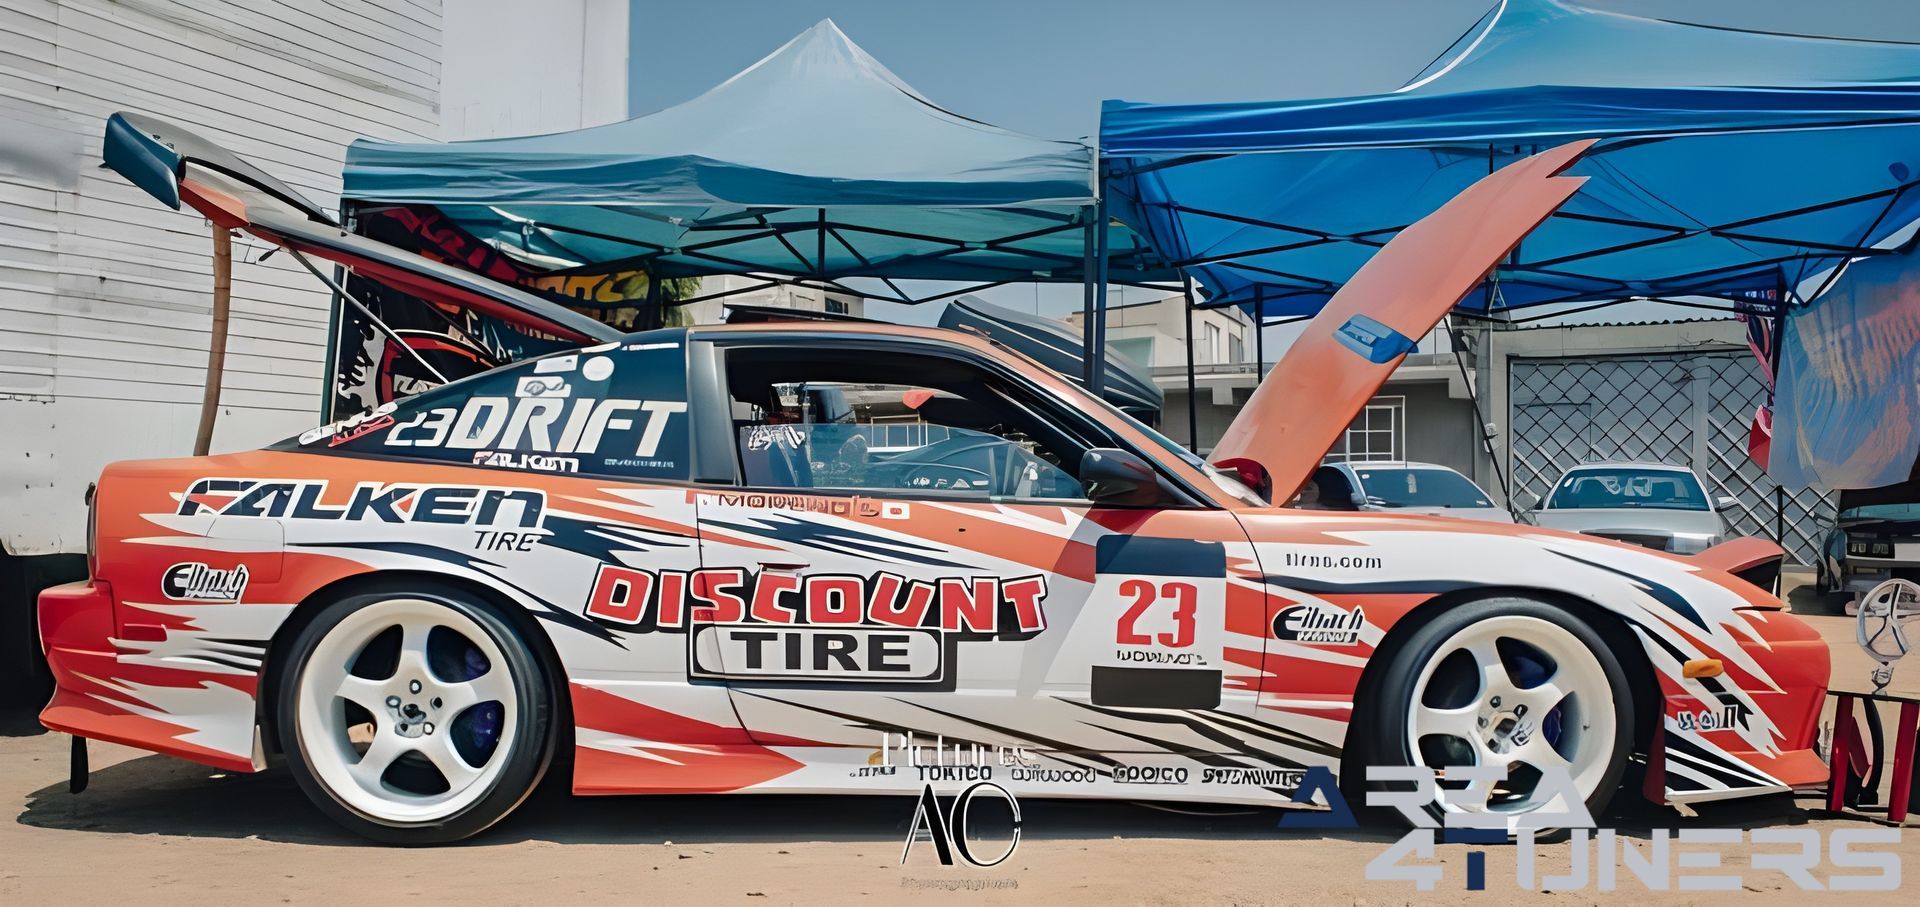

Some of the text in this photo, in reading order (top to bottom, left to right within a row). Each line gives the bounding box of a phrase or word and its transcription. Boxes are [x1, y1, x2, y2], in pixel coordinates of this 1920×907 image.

[177, 478, 544, 529] FALKEN
[474, 530, 538, 552] TIRE
[583, 564, 1047, 640] DISCOUNT
[1116, 579, 1198, 648] 23
[730, 631, 911, 672] TIRE
